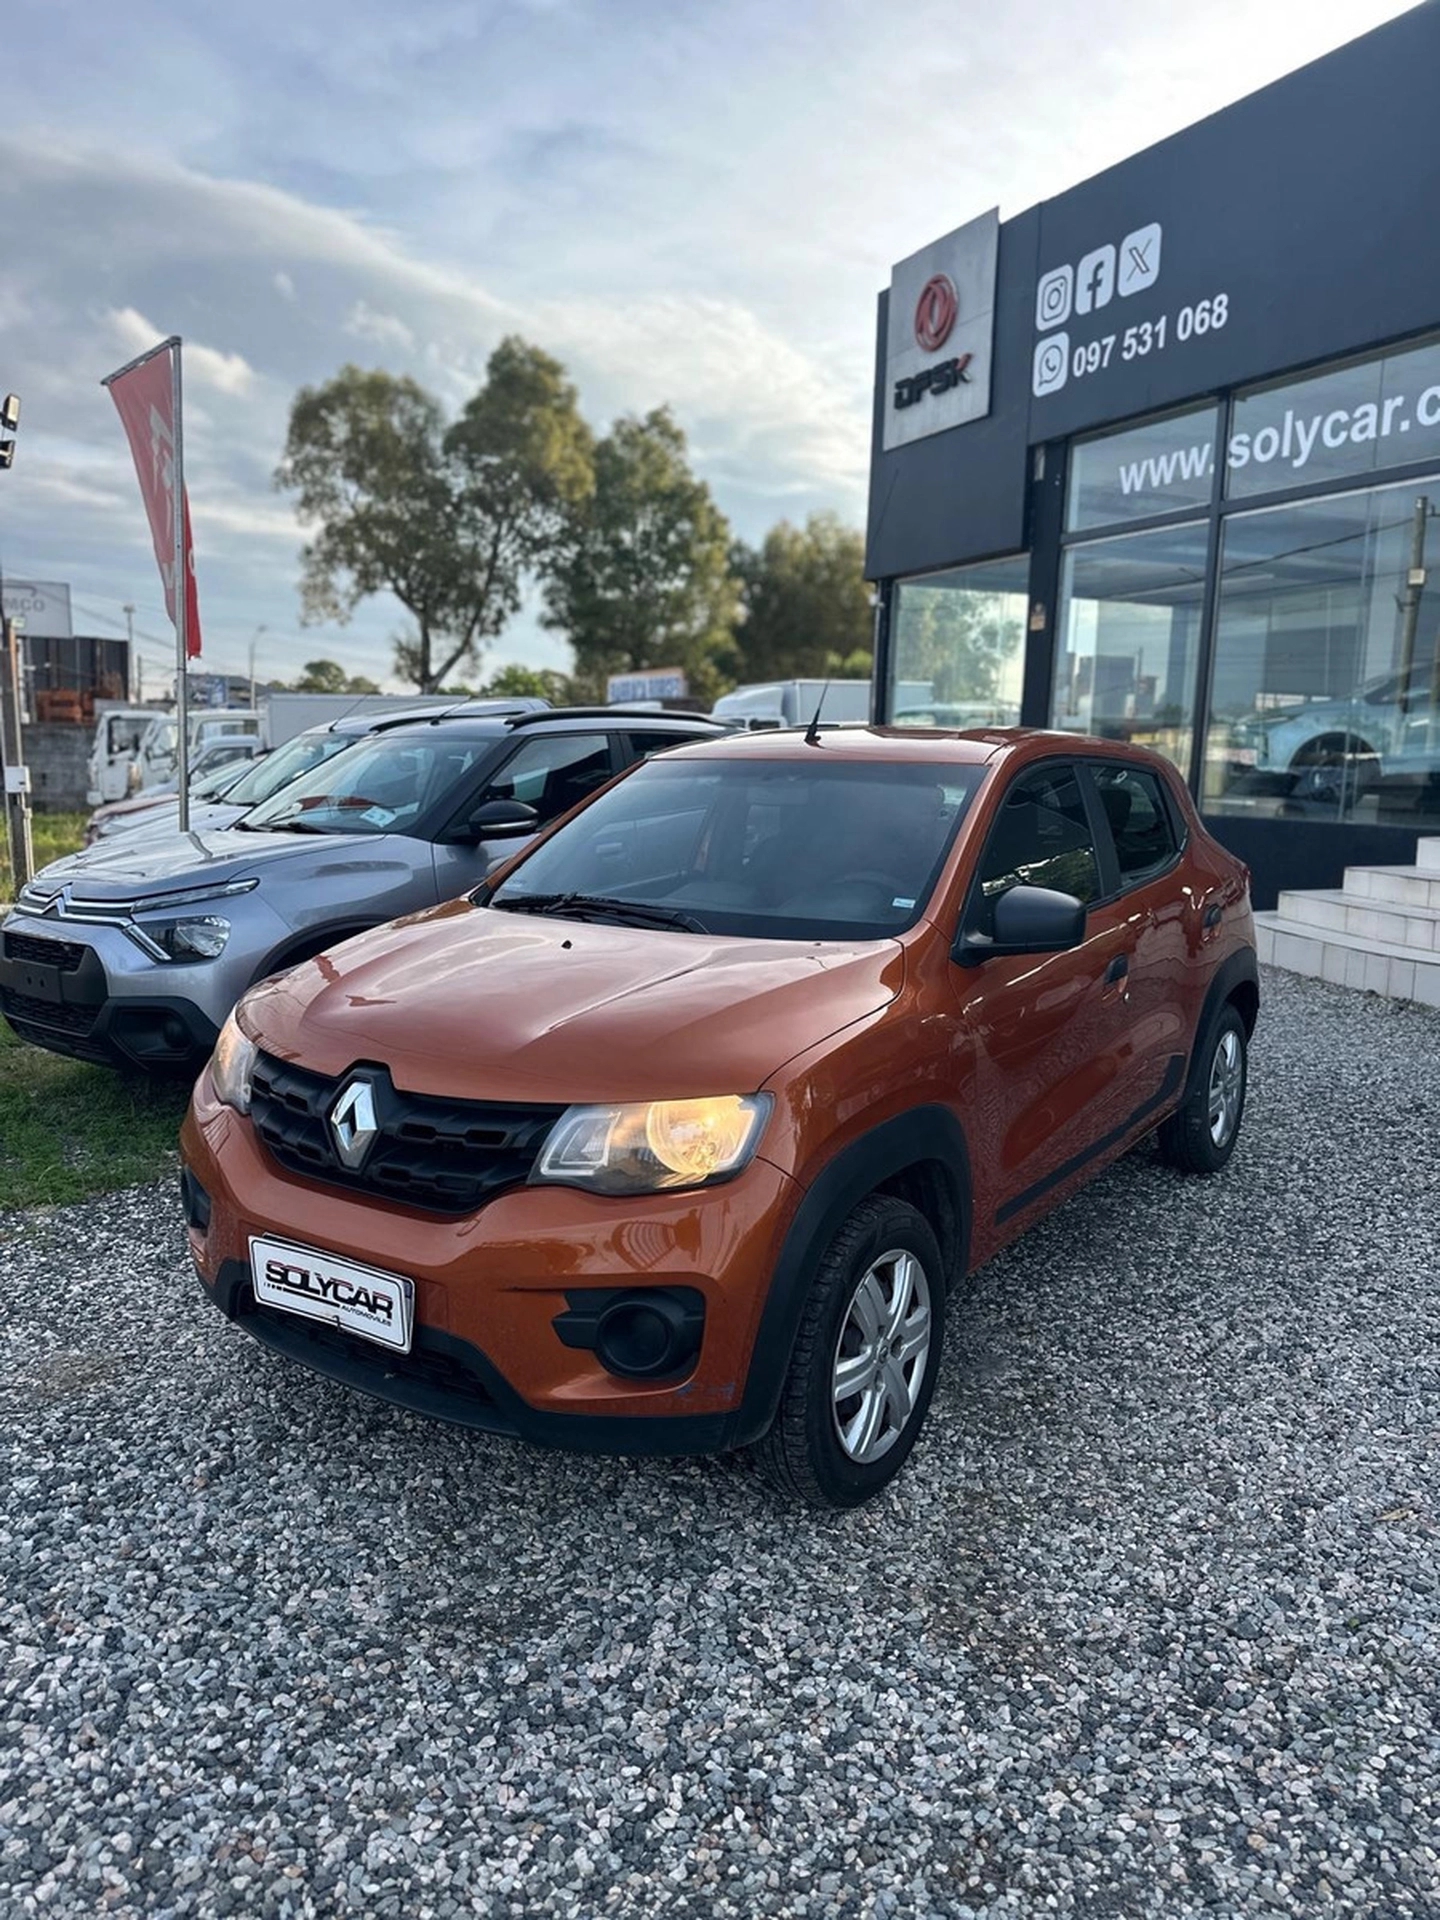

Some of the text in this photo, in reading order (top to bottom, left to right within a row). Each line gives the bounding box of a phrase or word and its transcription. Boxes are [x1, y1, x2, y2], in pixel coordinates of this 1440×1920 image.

[1073, 293, 1229, 378] 097 531 068
[265, 1259, 393, 1320] SOLYCAR
[341, 1304, 392, 1327] AUTOMOVILES
